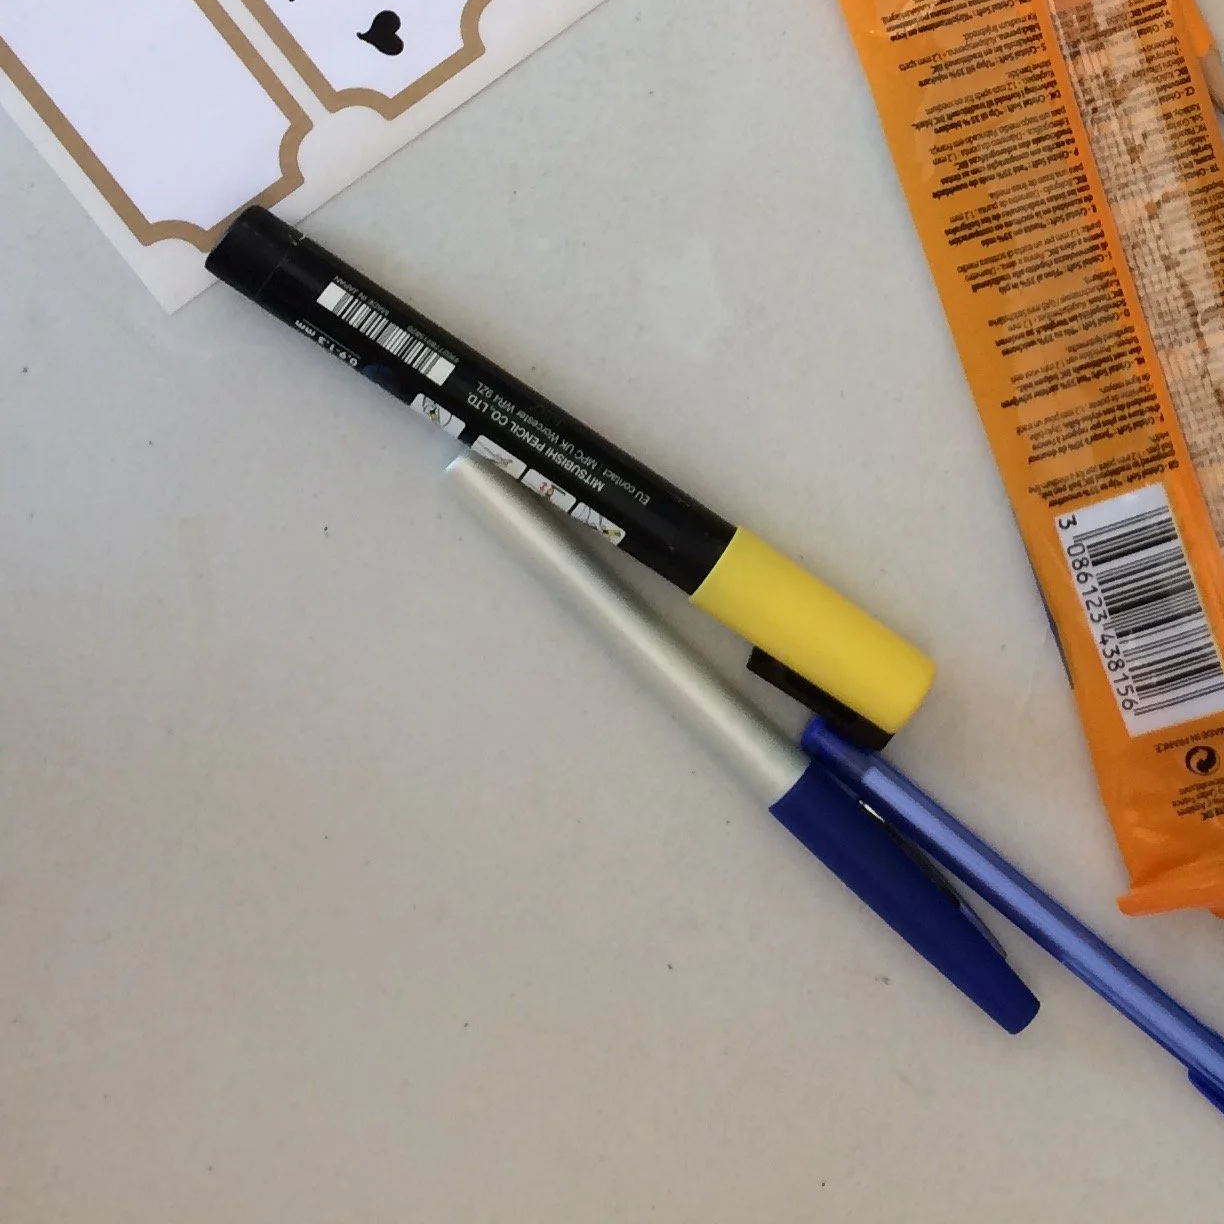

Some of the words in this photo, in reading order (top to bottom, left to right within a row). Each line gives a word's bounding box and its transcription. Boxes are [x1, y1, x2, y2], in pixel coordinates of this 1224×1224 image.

[332, 274, 360, 295] JAPAN
[292, 318, 317, 337] mm
[506, 419, 546, 452] PENCIL
[514, 408, 562, 444] Worcester
[558, 438, 575, 454] UK
[543, 445, 606, 492] MITSUBISHI
[573, 448, 598, 469] MPC
[600, 467, 636, 495] contact
[632, 489, 651, 506] EU
[1057, 514, 1078, 531] 3
[1065, 540, 1110, 625] 086123
[1096, 629, 1140, 713] 438156
[1153, 735, 1189, 753] FRANCE
